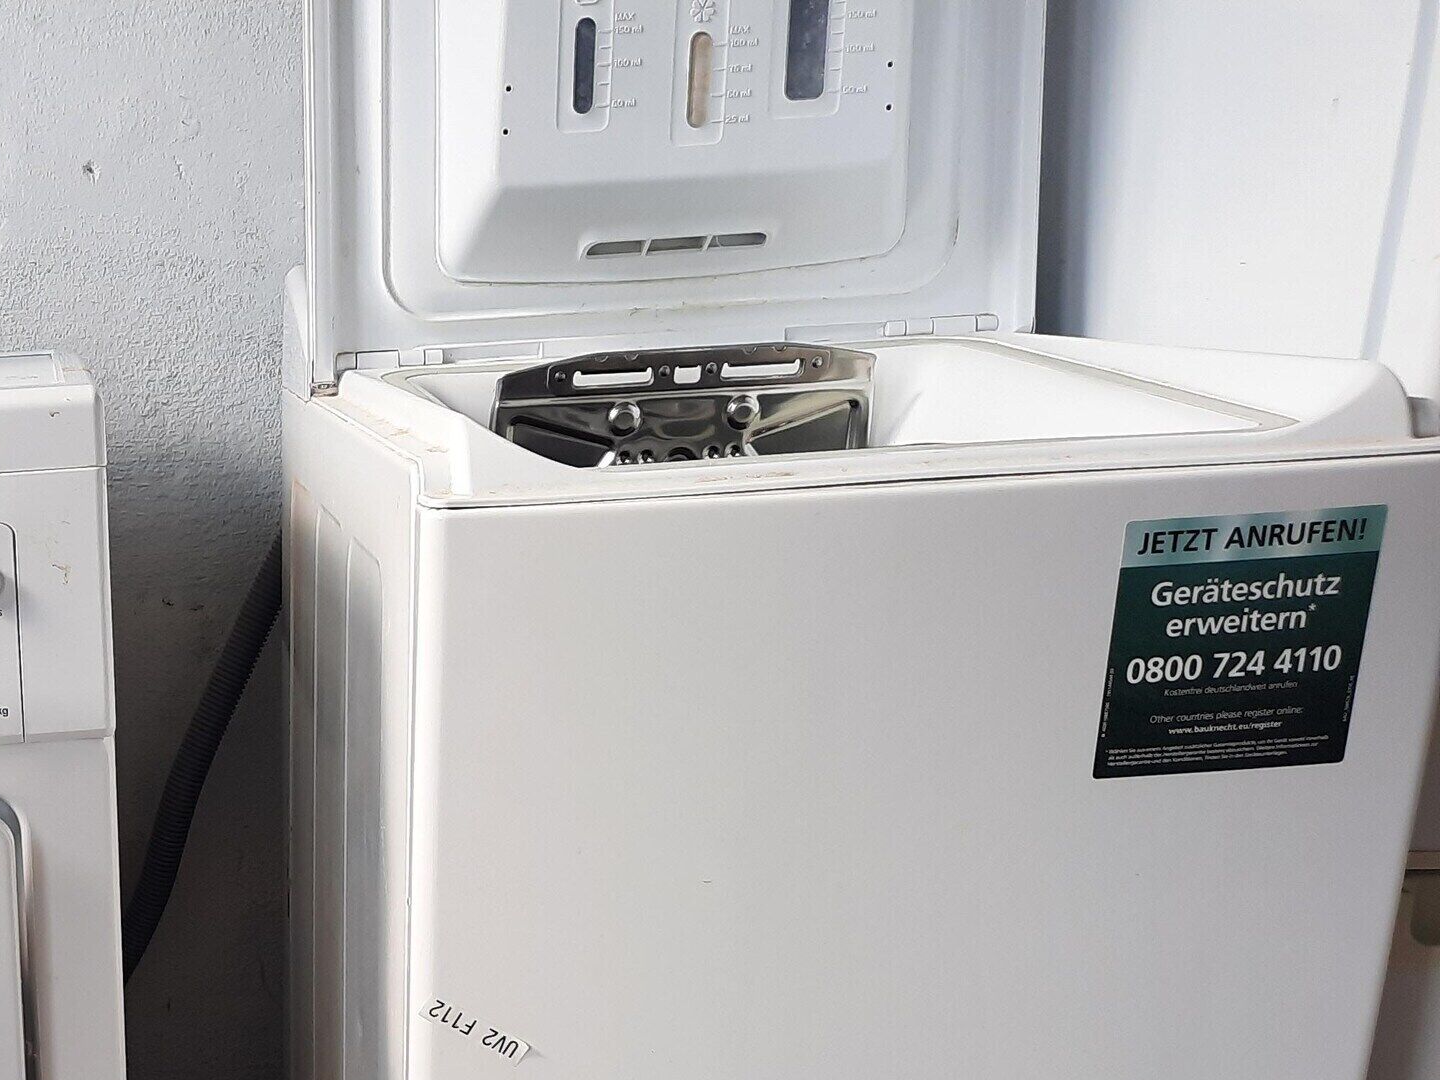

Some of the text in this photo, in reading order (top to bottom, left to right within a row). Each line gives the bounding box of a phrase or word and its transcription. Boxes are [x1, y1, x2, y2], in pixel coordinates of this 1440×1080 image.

[1137, 517, 1367, 556] JETZT ANRUFEN!
[1151, 572, 1342, 607] Geräteschutz
[1126, 645, 1342, 684] 0800 724 4110
[1149, 714, 1174, 724] Other
[1176, 712, 1214, 722] countries
[1216, 710, 1242, 722] please
[1244, 708, 1274, 719] register
[428, 999, 519, 1059] UV2 F112
